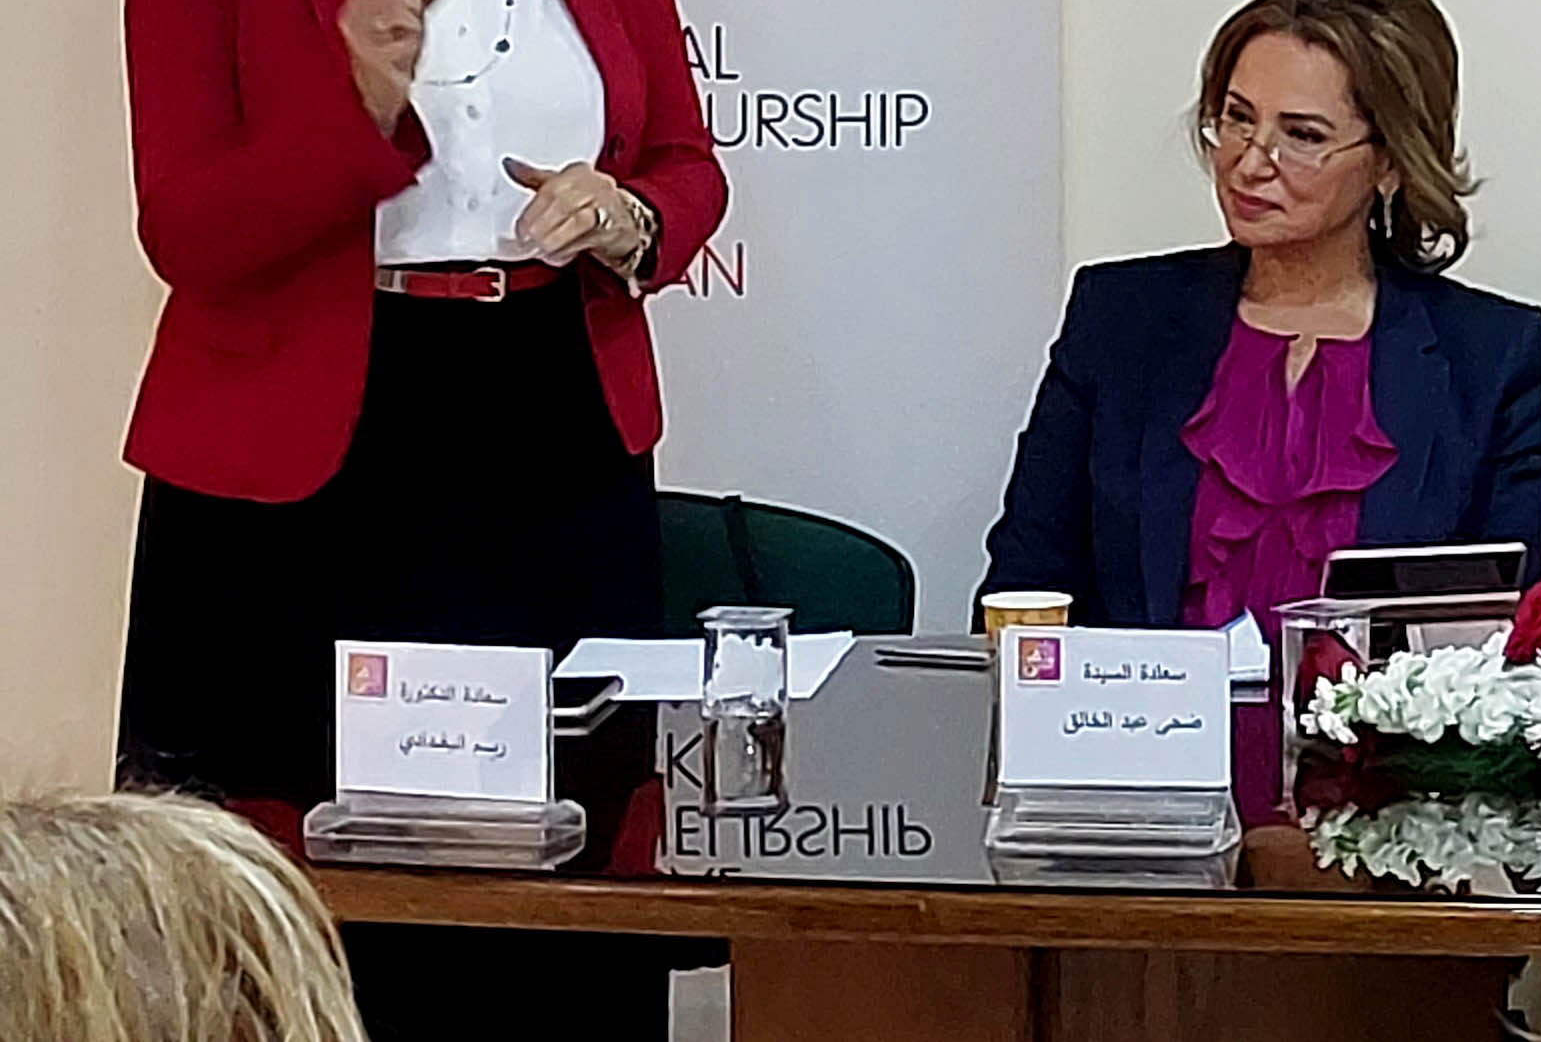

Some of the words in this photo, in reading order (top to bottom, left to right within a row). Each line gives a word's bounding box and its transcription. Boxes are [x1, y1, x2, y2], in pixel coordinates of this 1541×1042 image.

[1083, 662, 1131, 685] السيدة
[1140, 662, 1187, 681] سعادة
[1063, 711, 1113, 734] الخالق
[1120, 714, 1147, 734] عبد
